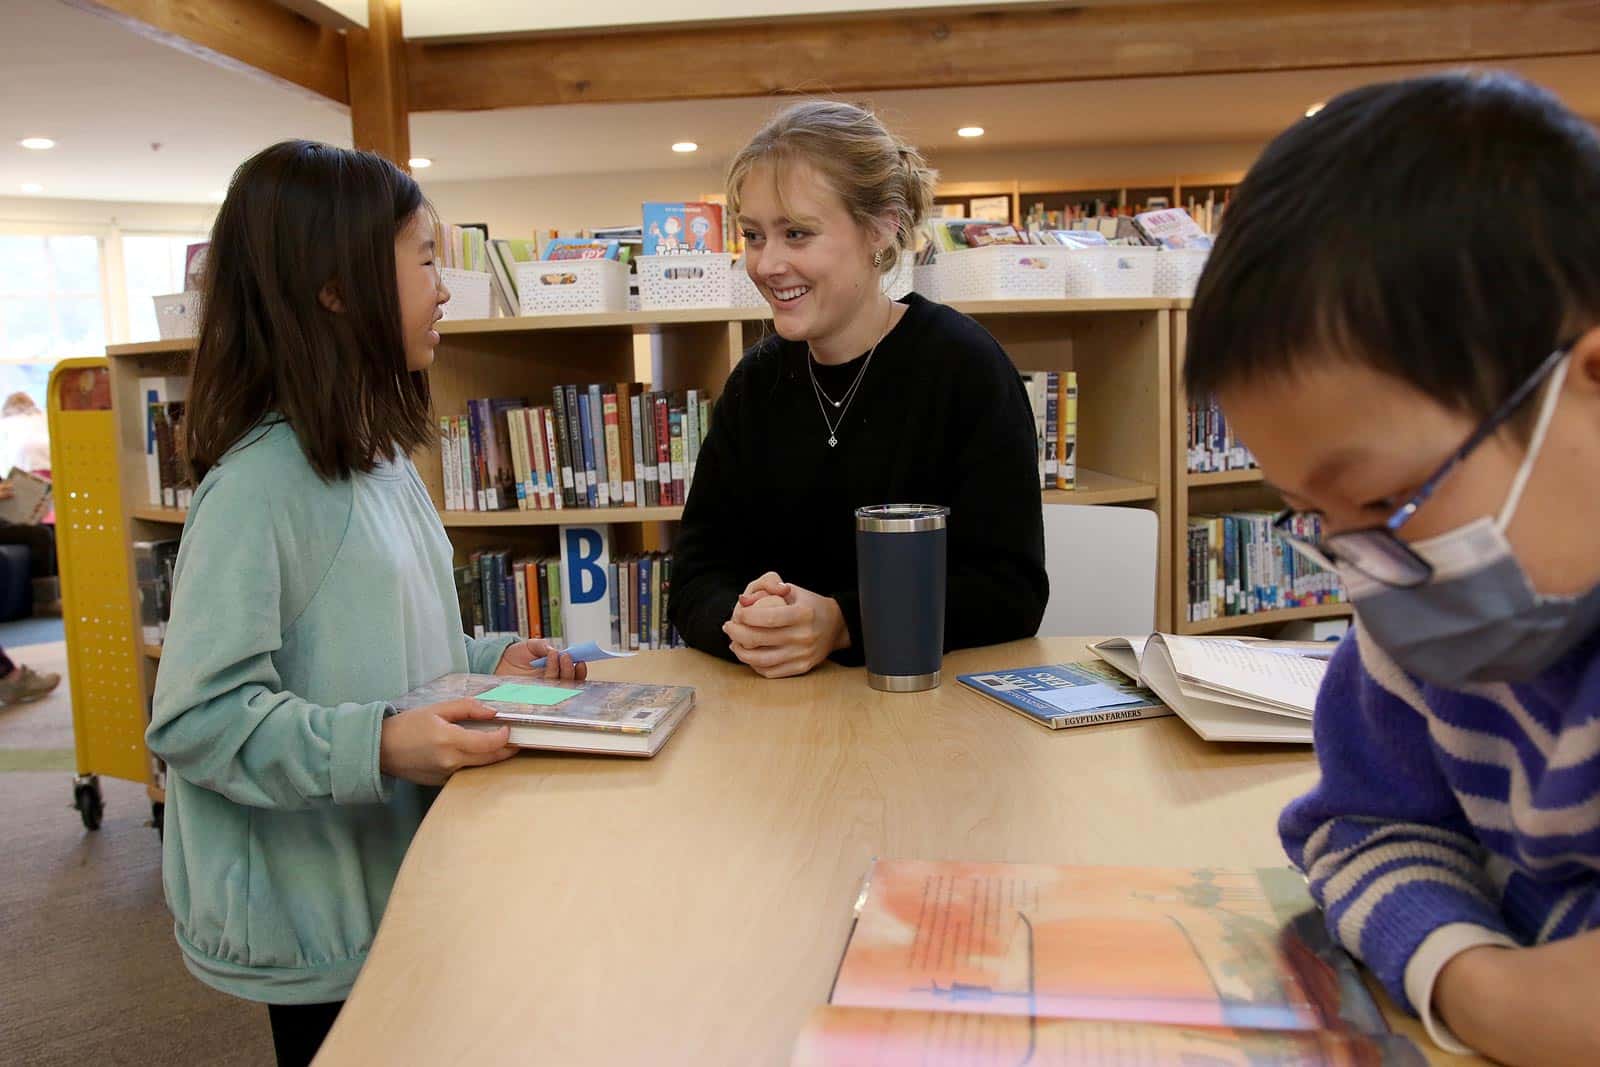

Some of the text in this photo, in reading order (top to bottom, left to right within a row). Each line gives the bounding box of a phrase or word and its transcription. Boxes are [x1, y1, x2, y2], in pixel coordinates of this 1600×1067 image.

[565, 527, 608, 604] B
[1064, 709, 1142, 726] EGYPTIAN FARMERS
